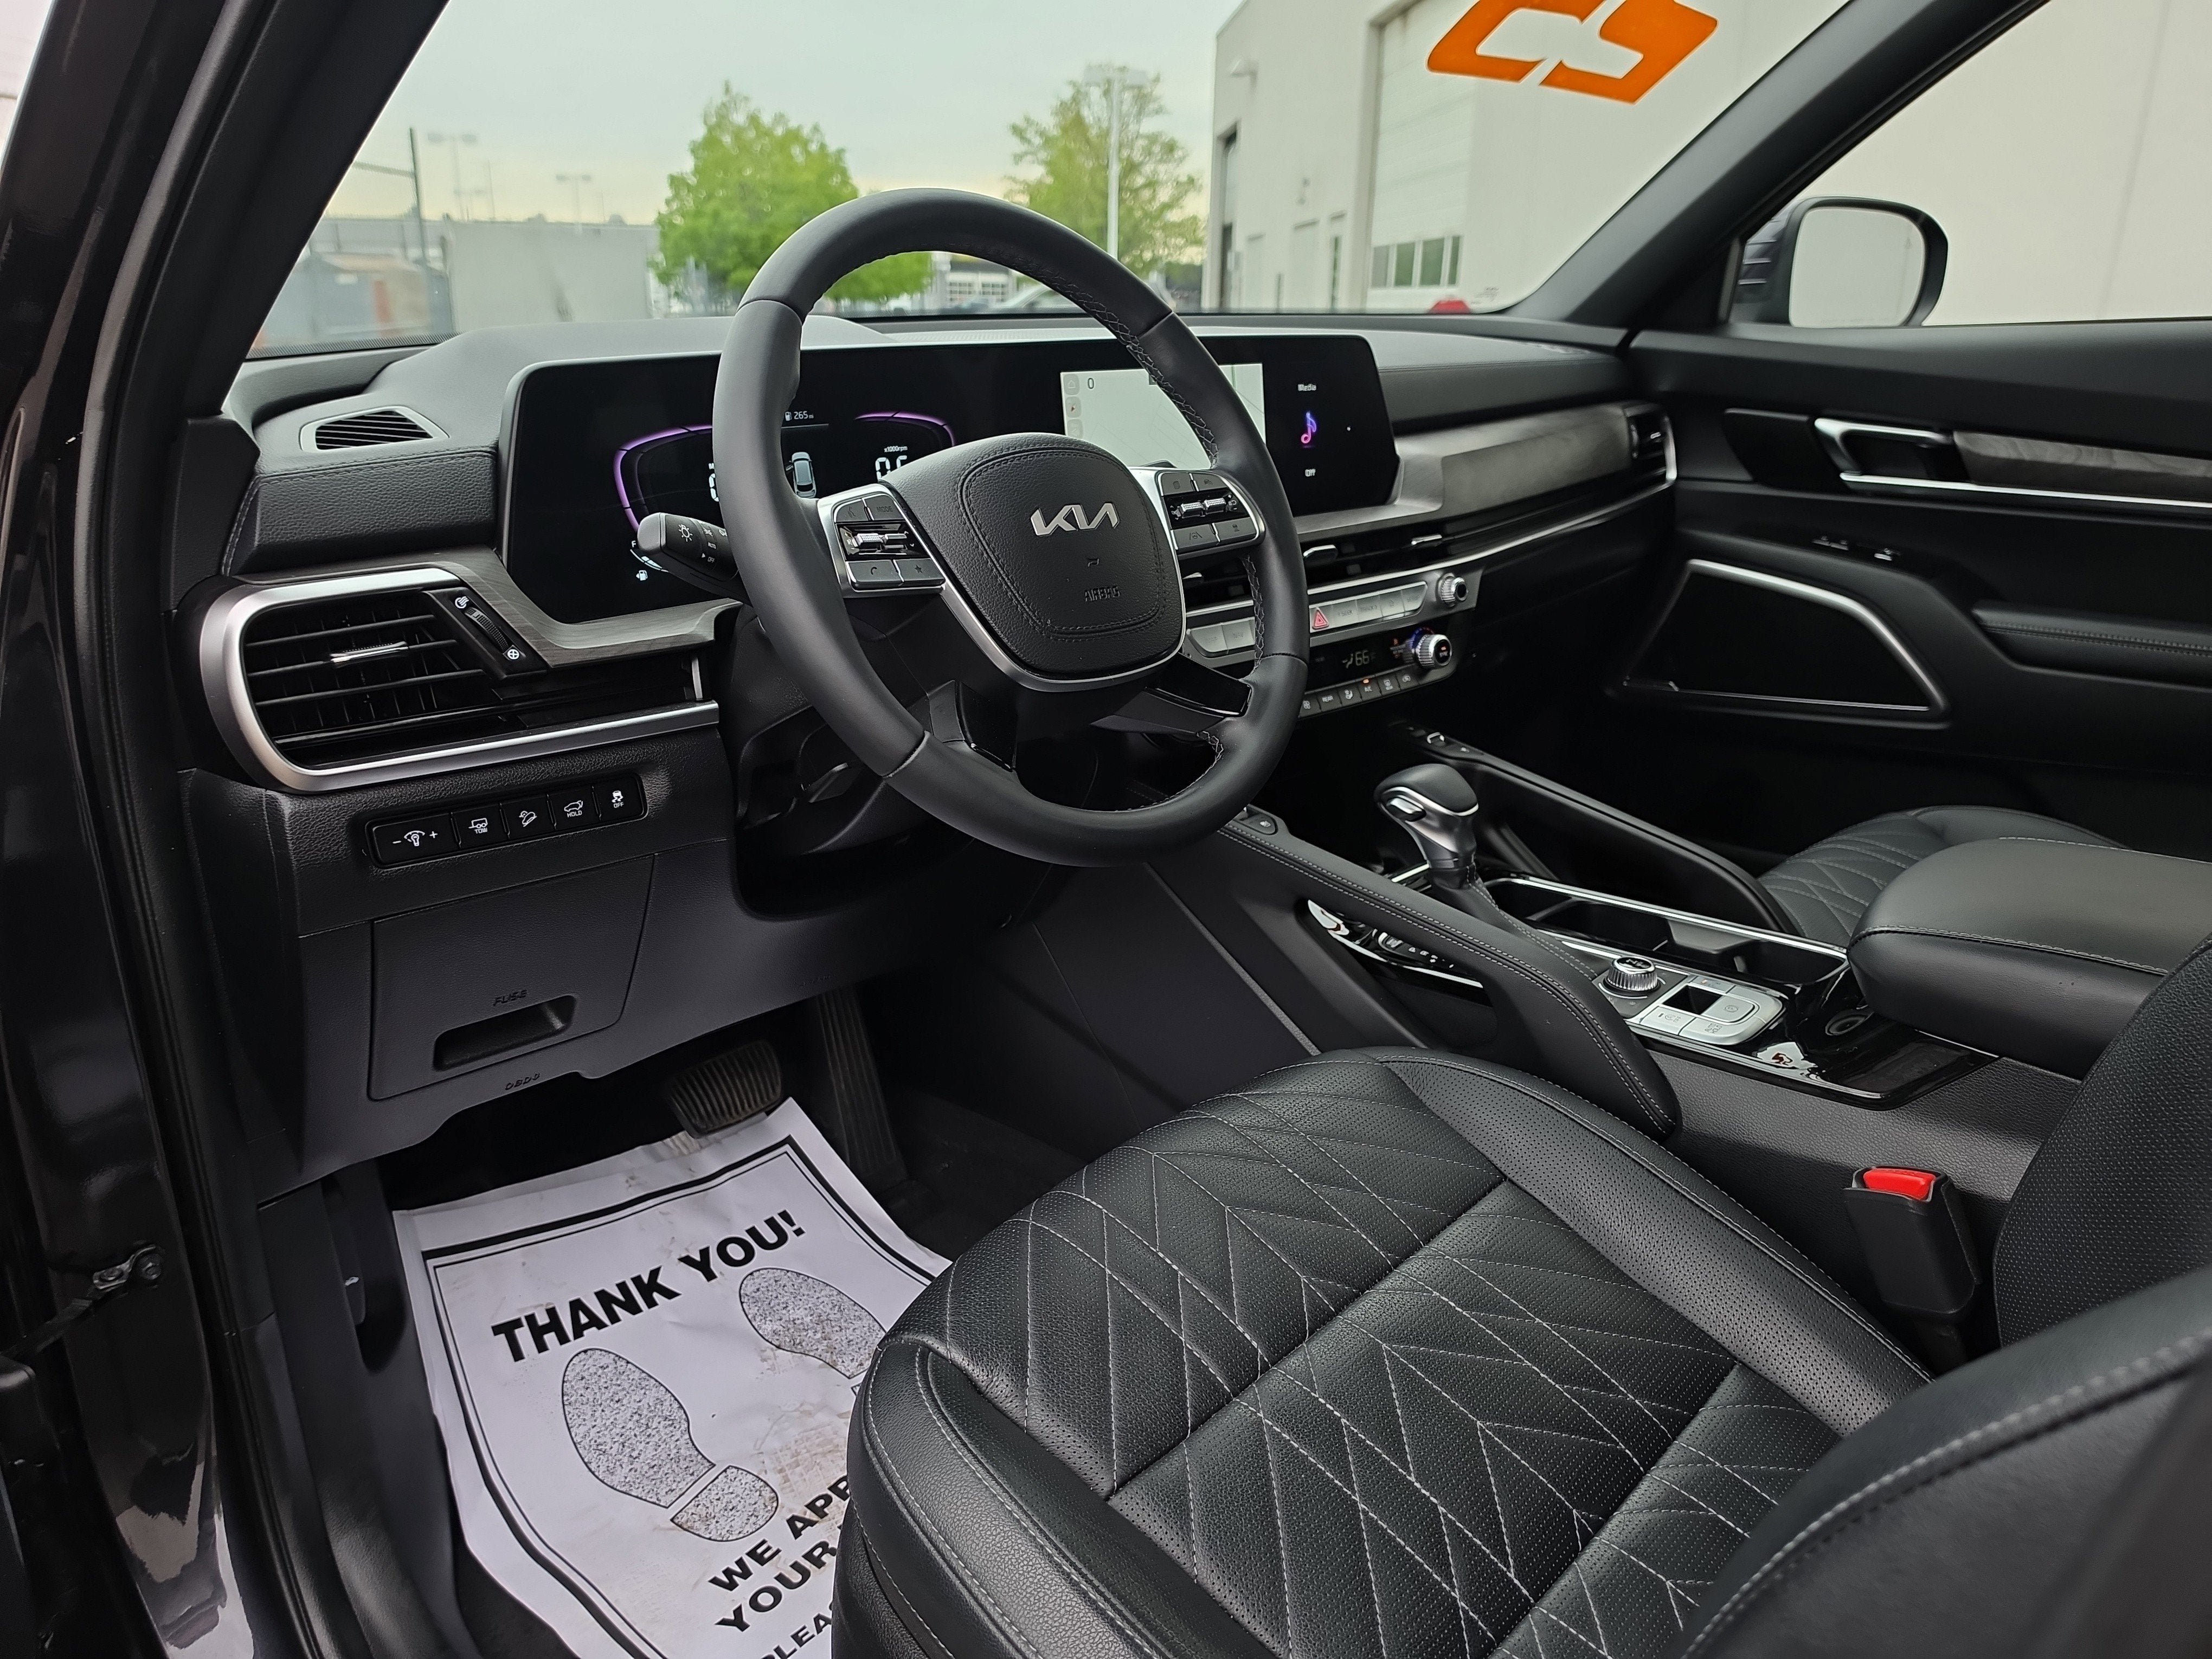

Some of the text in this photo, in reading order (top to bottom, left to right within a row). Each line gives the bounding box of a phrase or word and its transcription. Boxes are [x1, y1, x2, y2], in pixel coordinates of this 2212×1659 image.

[794, 411, 808, 419] 265
[1305, 468, 1316, 477] Off
[1031, 502, 1120, 536] KIA
[1355, 650, 1369, 666] 66
[567, 810, 583, 818] HOLD
[493, 989, 528, 1007] FUSE
[491, 1209, 806, 1362] THANK YOU!
[708, 1538, 783, 1592] WE
[714, 1540, 838, 1632] YOUR
